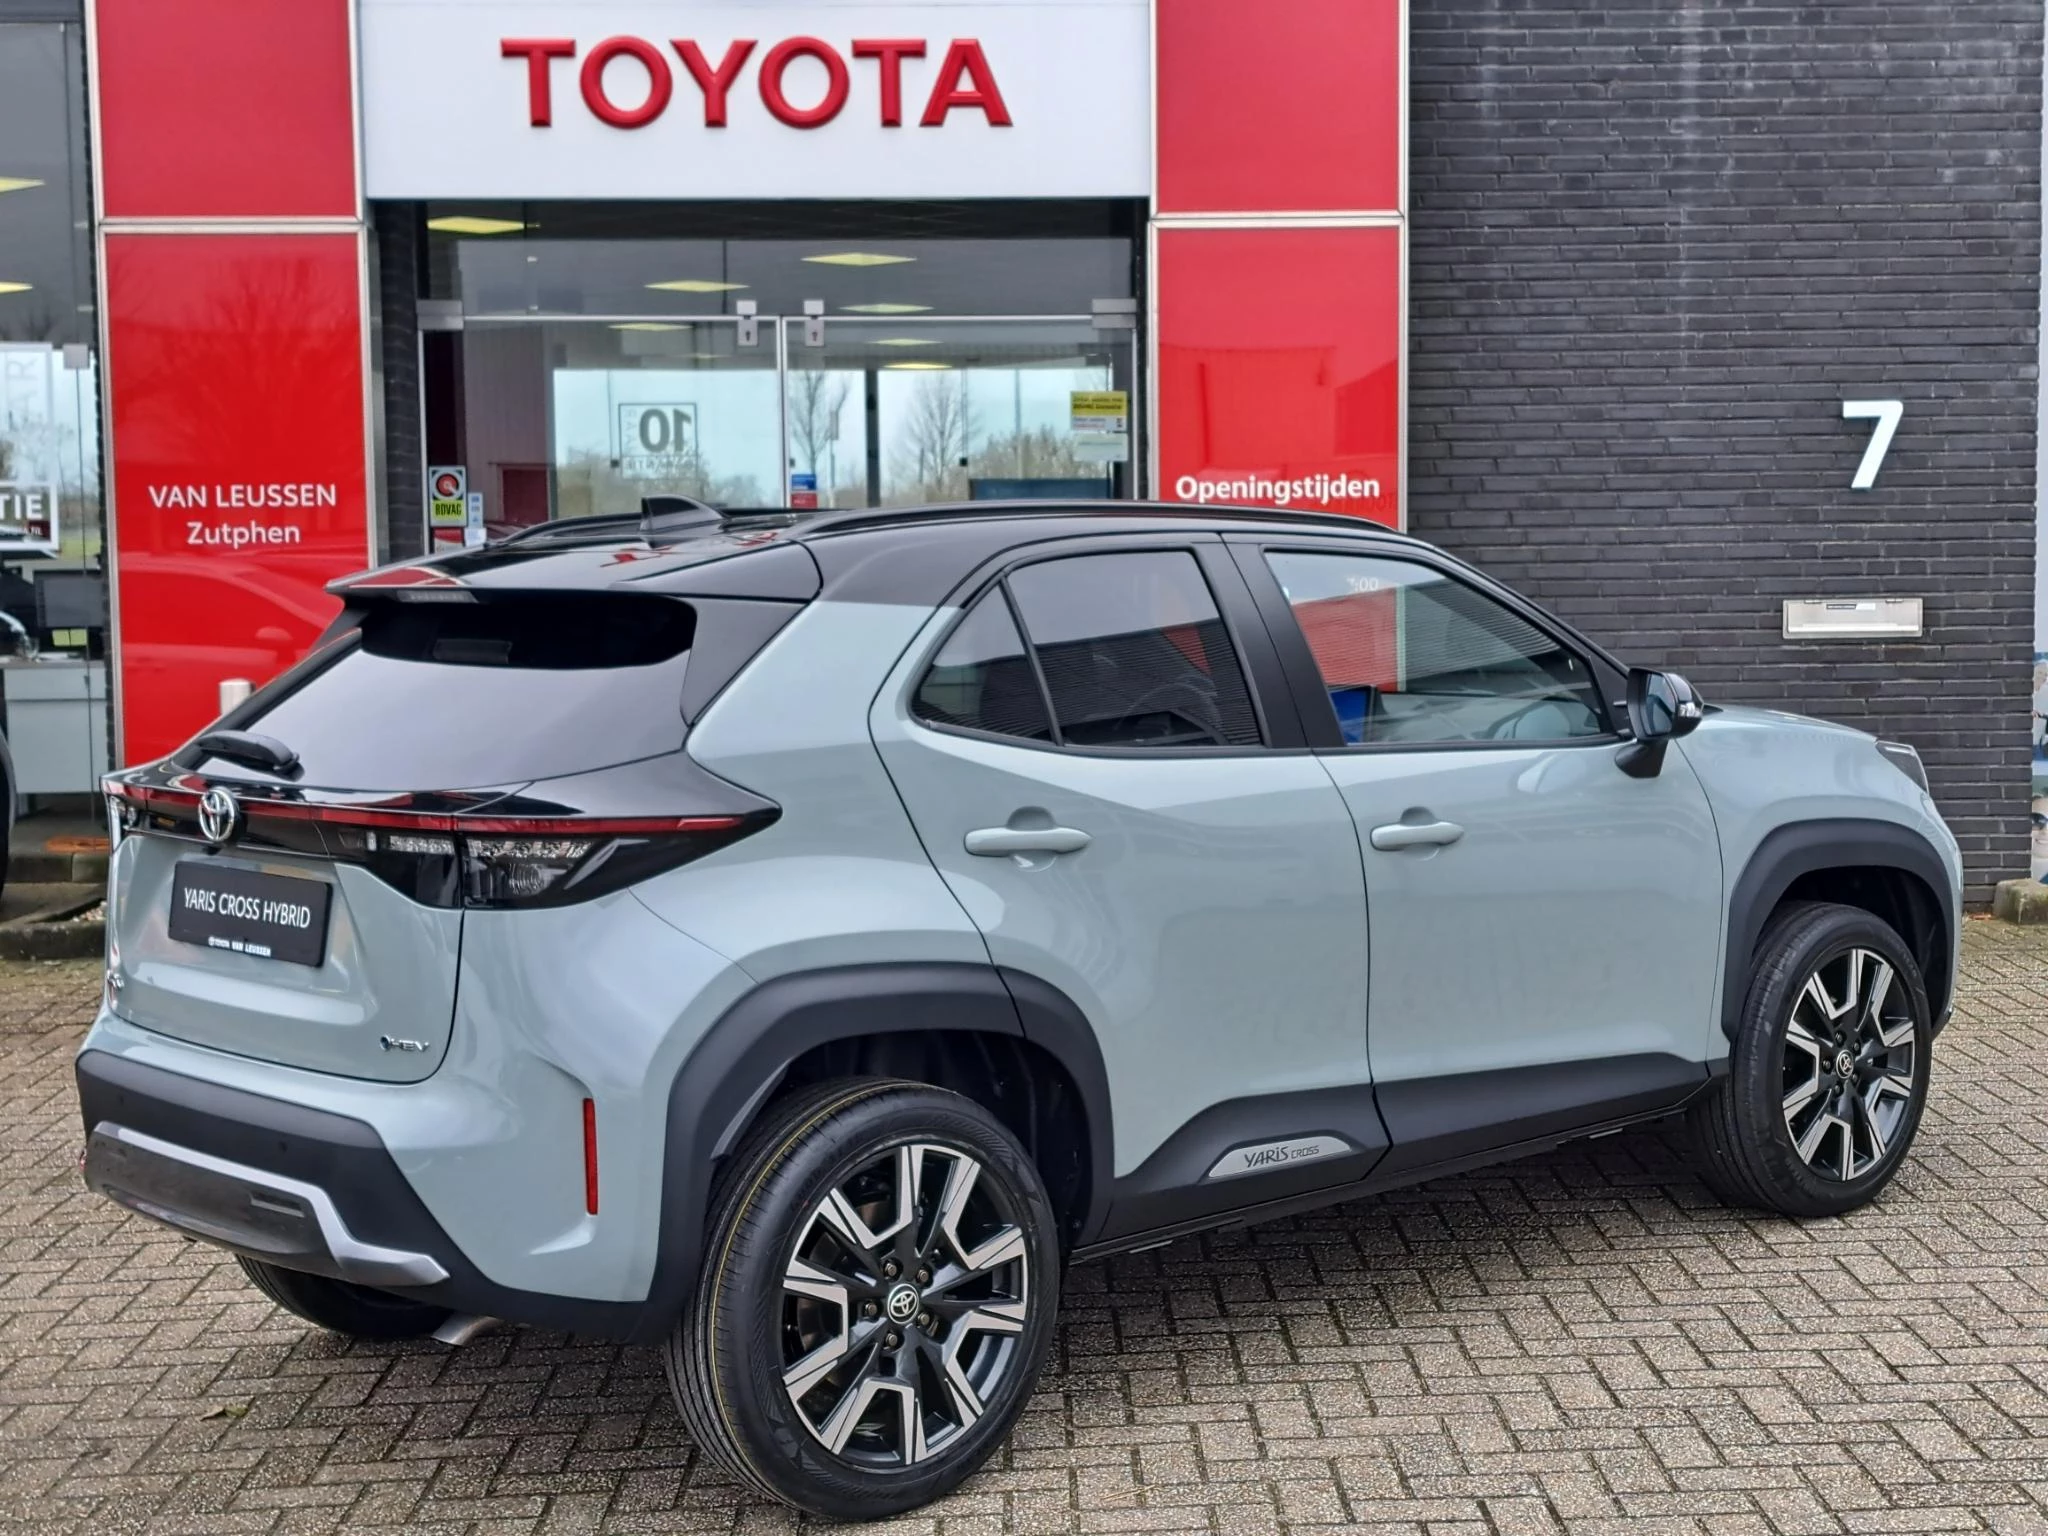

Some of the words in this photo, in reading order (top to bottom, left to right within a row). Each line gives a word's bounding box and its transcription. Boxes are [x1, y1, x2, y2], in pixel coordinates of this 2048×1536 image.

[500, 35, 1014, 130] TOYOTA
[1843, 400, 1904, 489] 7
[148, 484, 208, 508] VAN
[215, 483, 337, 508] LEUSSEN
[1175, 474, 1381, 505] Openingstijden
[186, 520, 301, 550] Zutphen
[184, 887, 216, 914] YARIS
[218, 893, 261, 921] CROSS
[263, 901, 311, 928] HYBRID
[1291, 1145, 1320, 1159] CROSS
